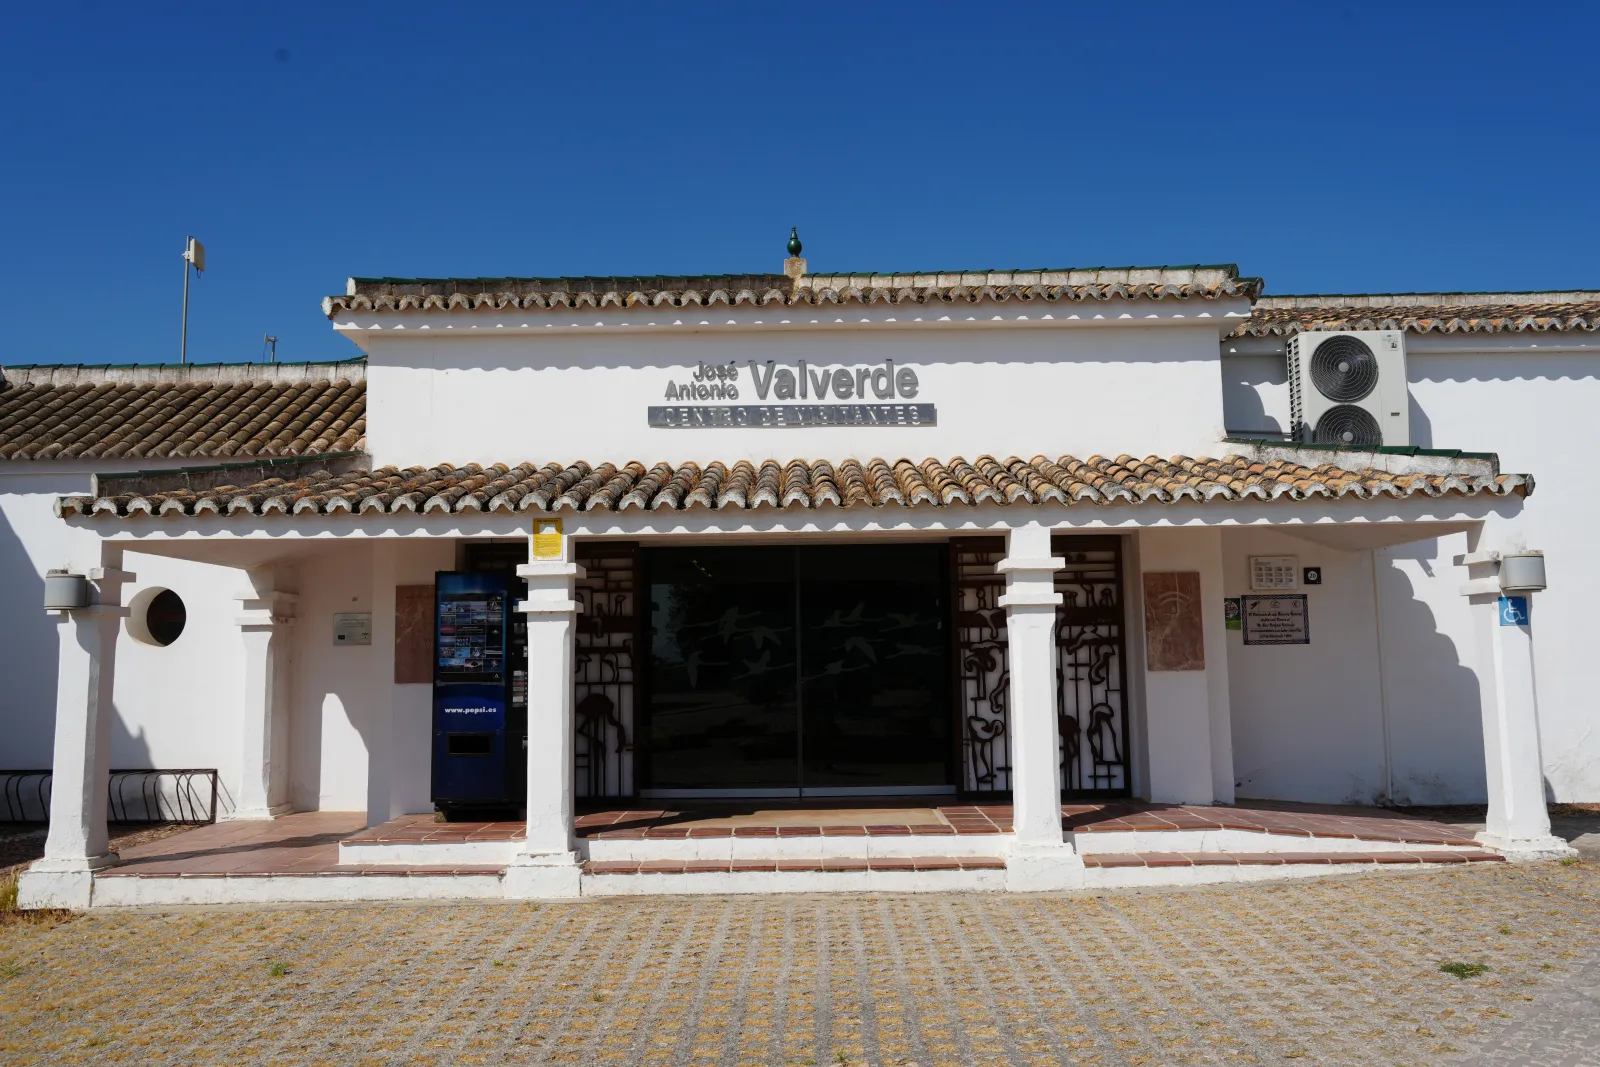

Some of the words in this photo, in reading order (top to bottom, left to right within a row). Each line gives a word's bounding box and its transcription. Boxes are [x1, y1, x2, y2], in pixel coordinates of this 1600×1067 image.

[693, 361, 739, 381] José
[748, 359, 919, 400] Valverde
[664, 380, 739, 401] Antonio
[665, 407, 747, 426] CENTRO
[759, 407, 787, 426] DE
[793, 405, 920, 425] VISITANTES
[444, 706, 497, 715] www.pepsi.es
